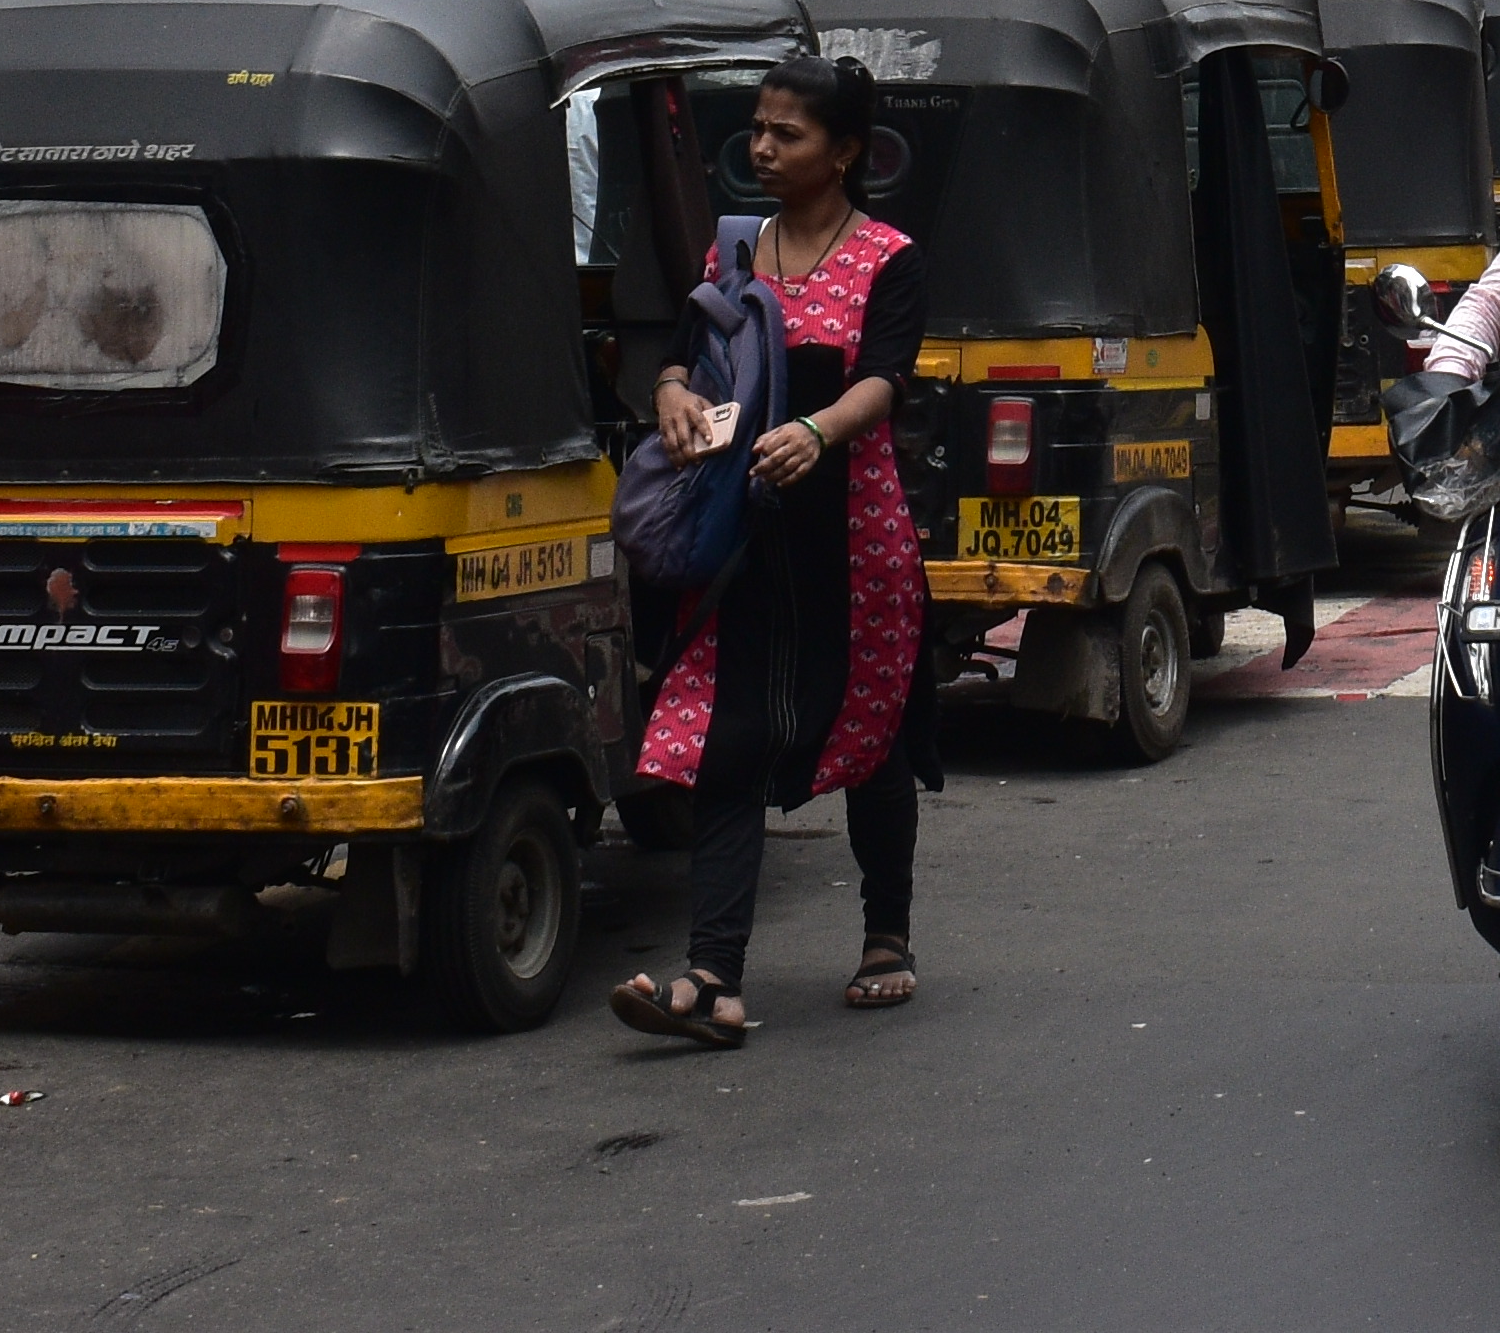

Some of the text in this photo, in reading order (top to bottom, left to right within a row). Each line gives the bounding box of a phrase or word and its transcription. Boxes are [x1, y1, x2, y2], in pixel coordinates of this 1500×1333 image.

[227, 70, 248, 85] ठाणे
[92, 138, 141, 161] ठाणे
[145, 142, 195, 161] शहर
[505, 493, 523, 517] CNG
[966, 530, 1075, 558] JQ.7049
[460, 539, 574, 592] MH 04 JH 5131
[10, 732, 55, 749] सुरक्षित
[59, 732, 90, 747] अंतर
[255, 734, 376, 775] 5131
